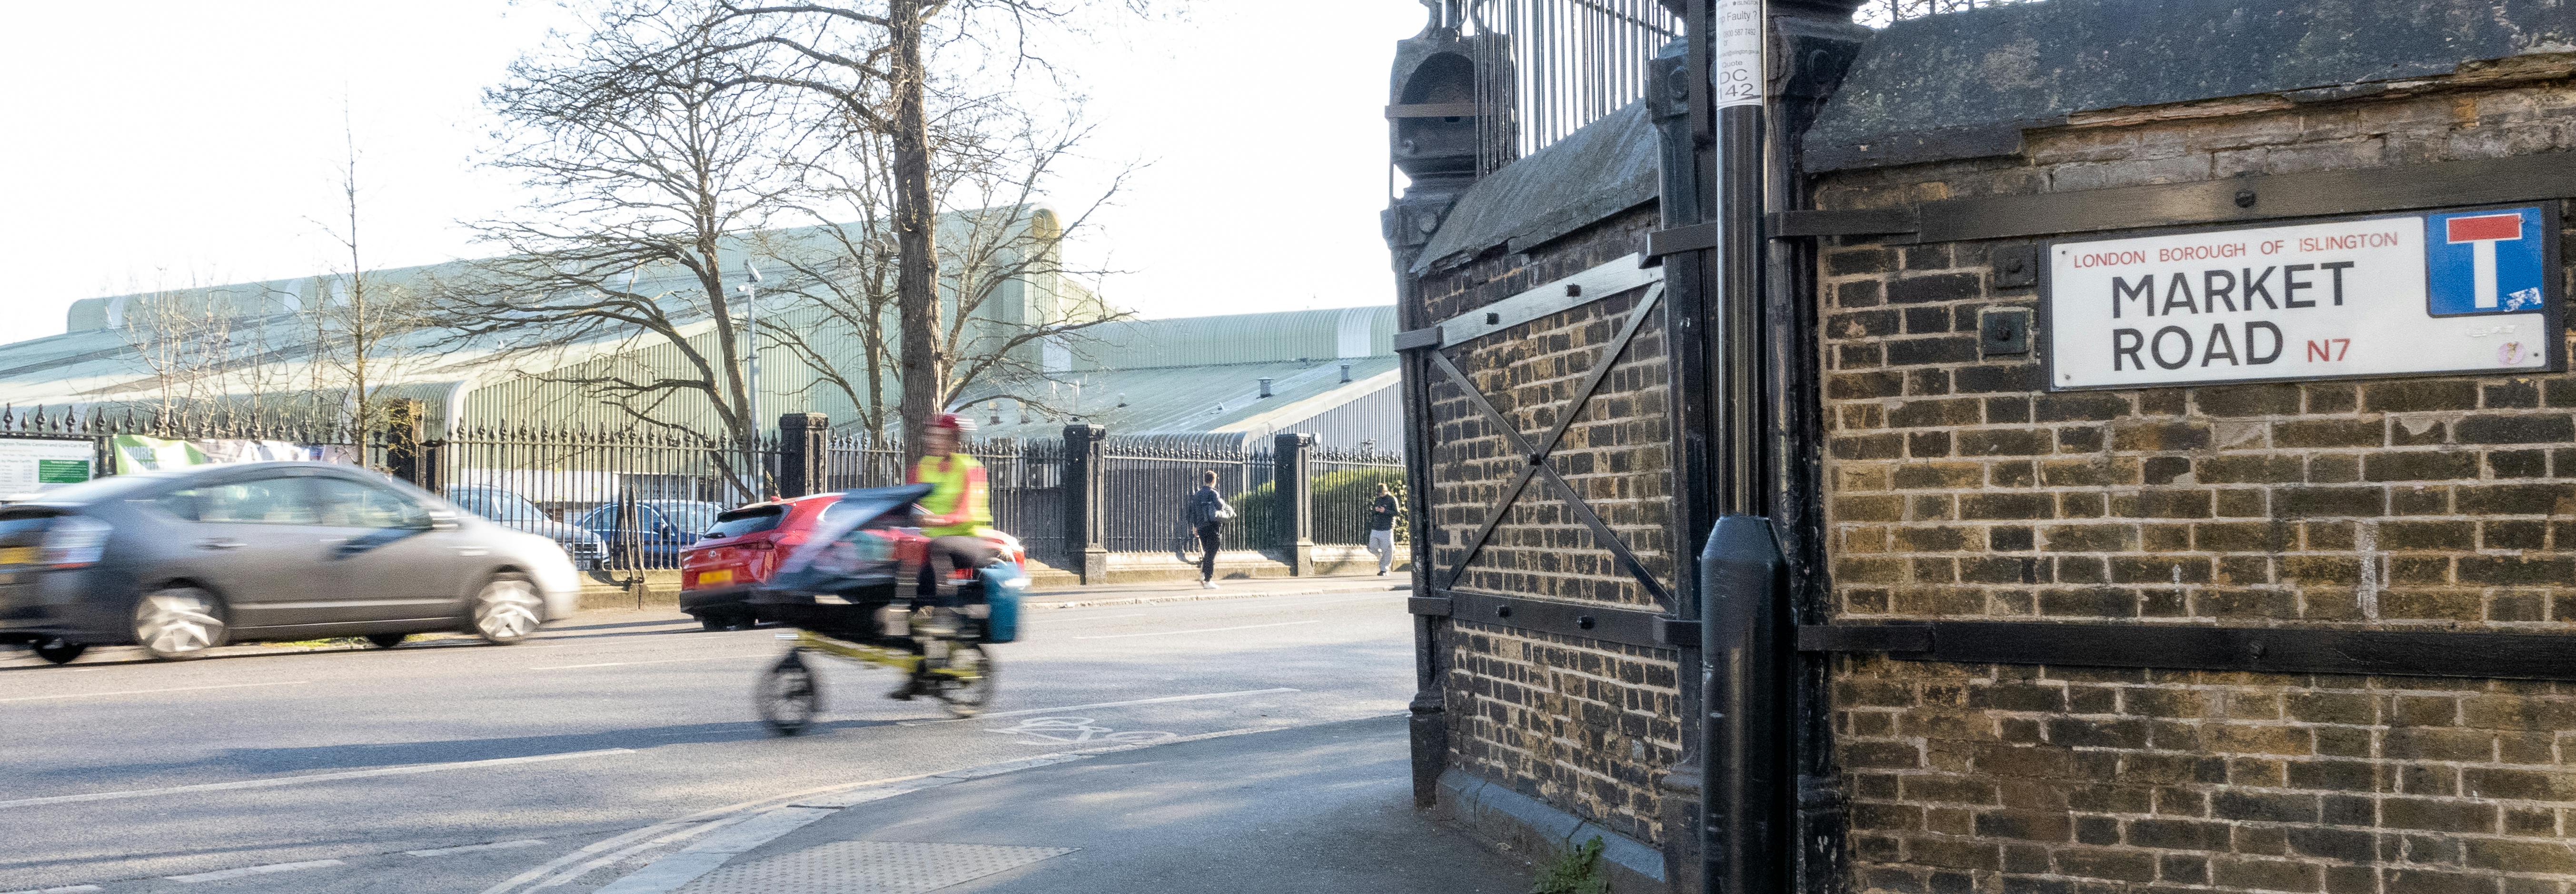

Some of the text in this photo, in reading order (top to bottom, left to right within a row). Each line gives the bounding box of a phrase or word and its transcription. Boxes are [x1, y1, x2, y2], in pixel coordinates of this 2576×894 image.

[1727, 10, 1750, 22] Faulty
[1720, 69, 1747, 85] DC
[2074, 232, 2398, 268] LONDON BOROUGH OF ISLINGTON
[2113, 261, 2354, 318] MARKET
[2113, 321, 2350, 371] ROAD N7
